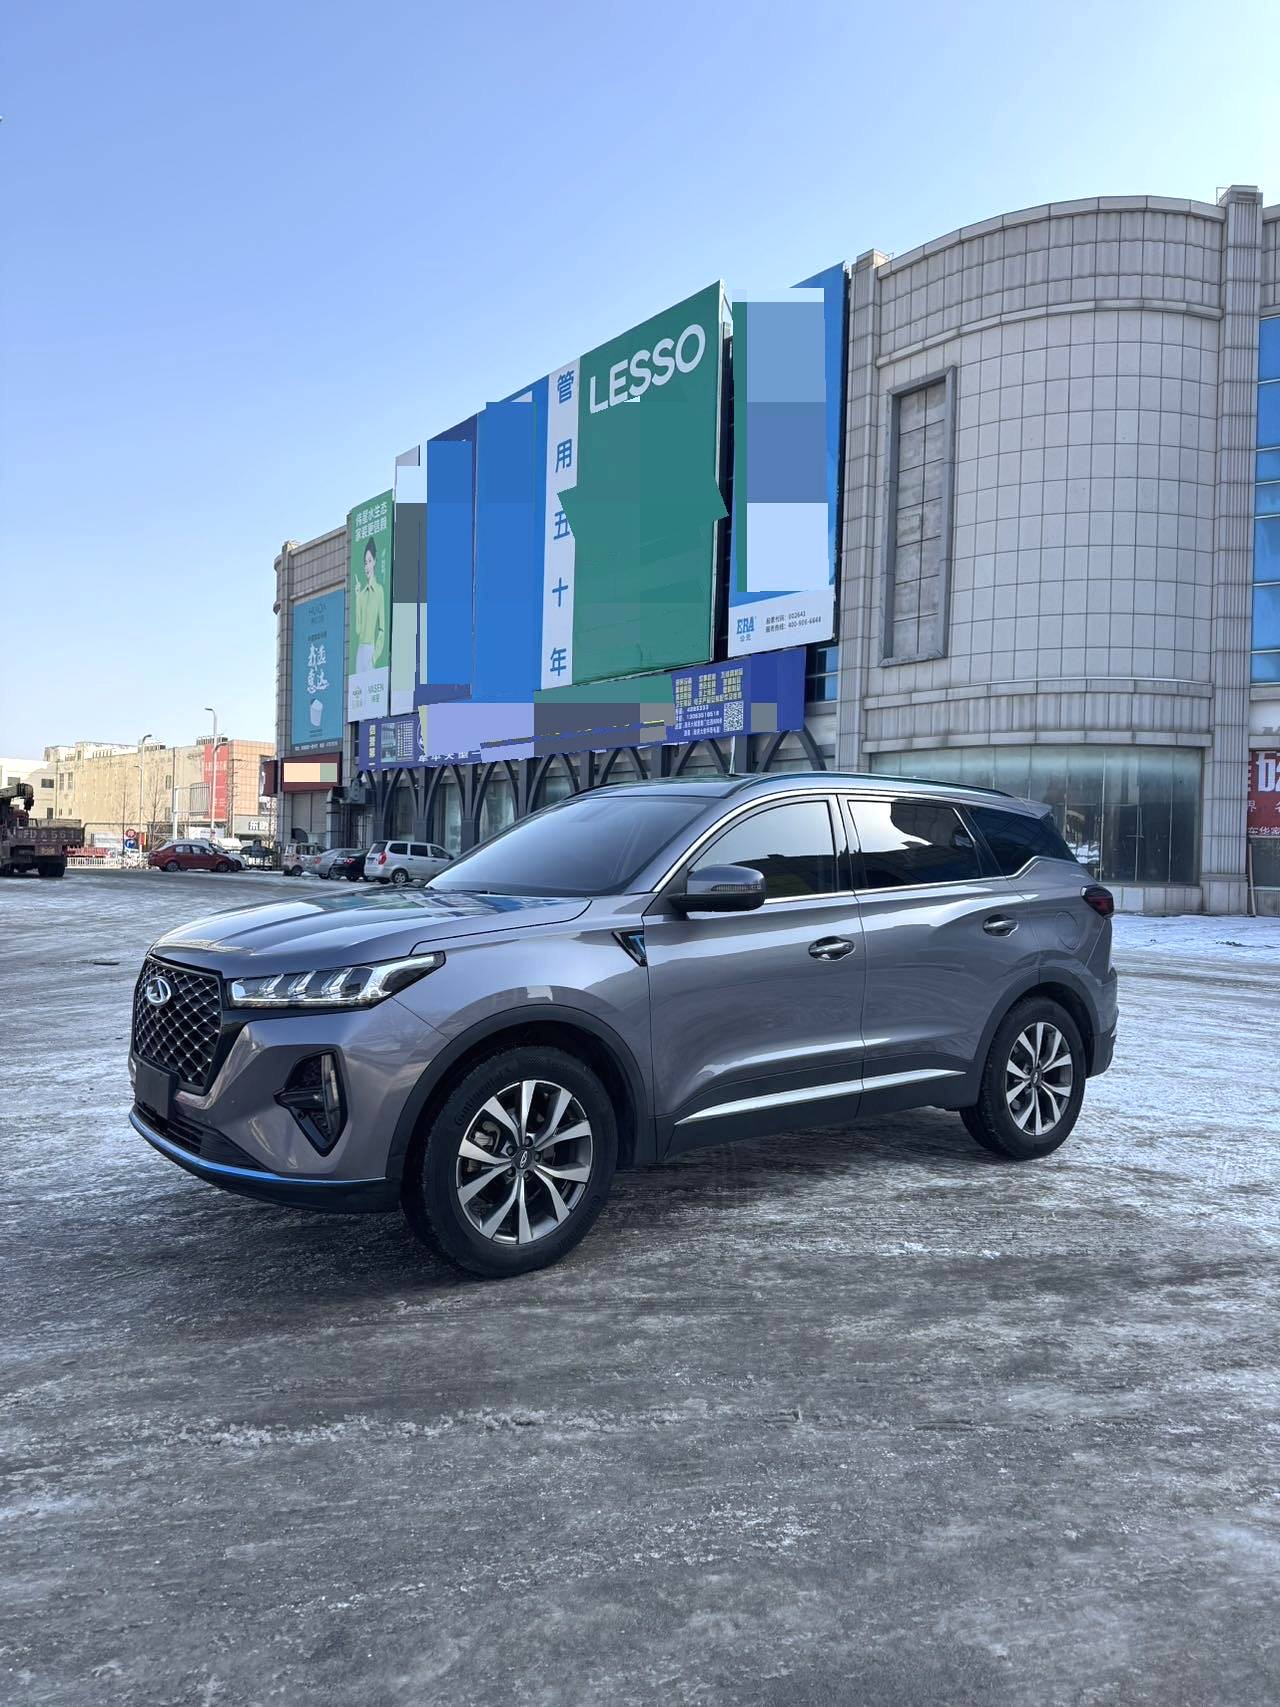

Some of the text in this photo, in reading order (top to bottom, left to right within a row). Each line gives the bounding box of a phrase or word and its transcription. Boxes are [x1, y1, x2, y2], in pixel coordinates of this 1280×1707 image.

[590, 323, 706, 414] LESSO
[549, 369, 575, 677] 管用五十年
[737, 616, 755, 634] ERA
